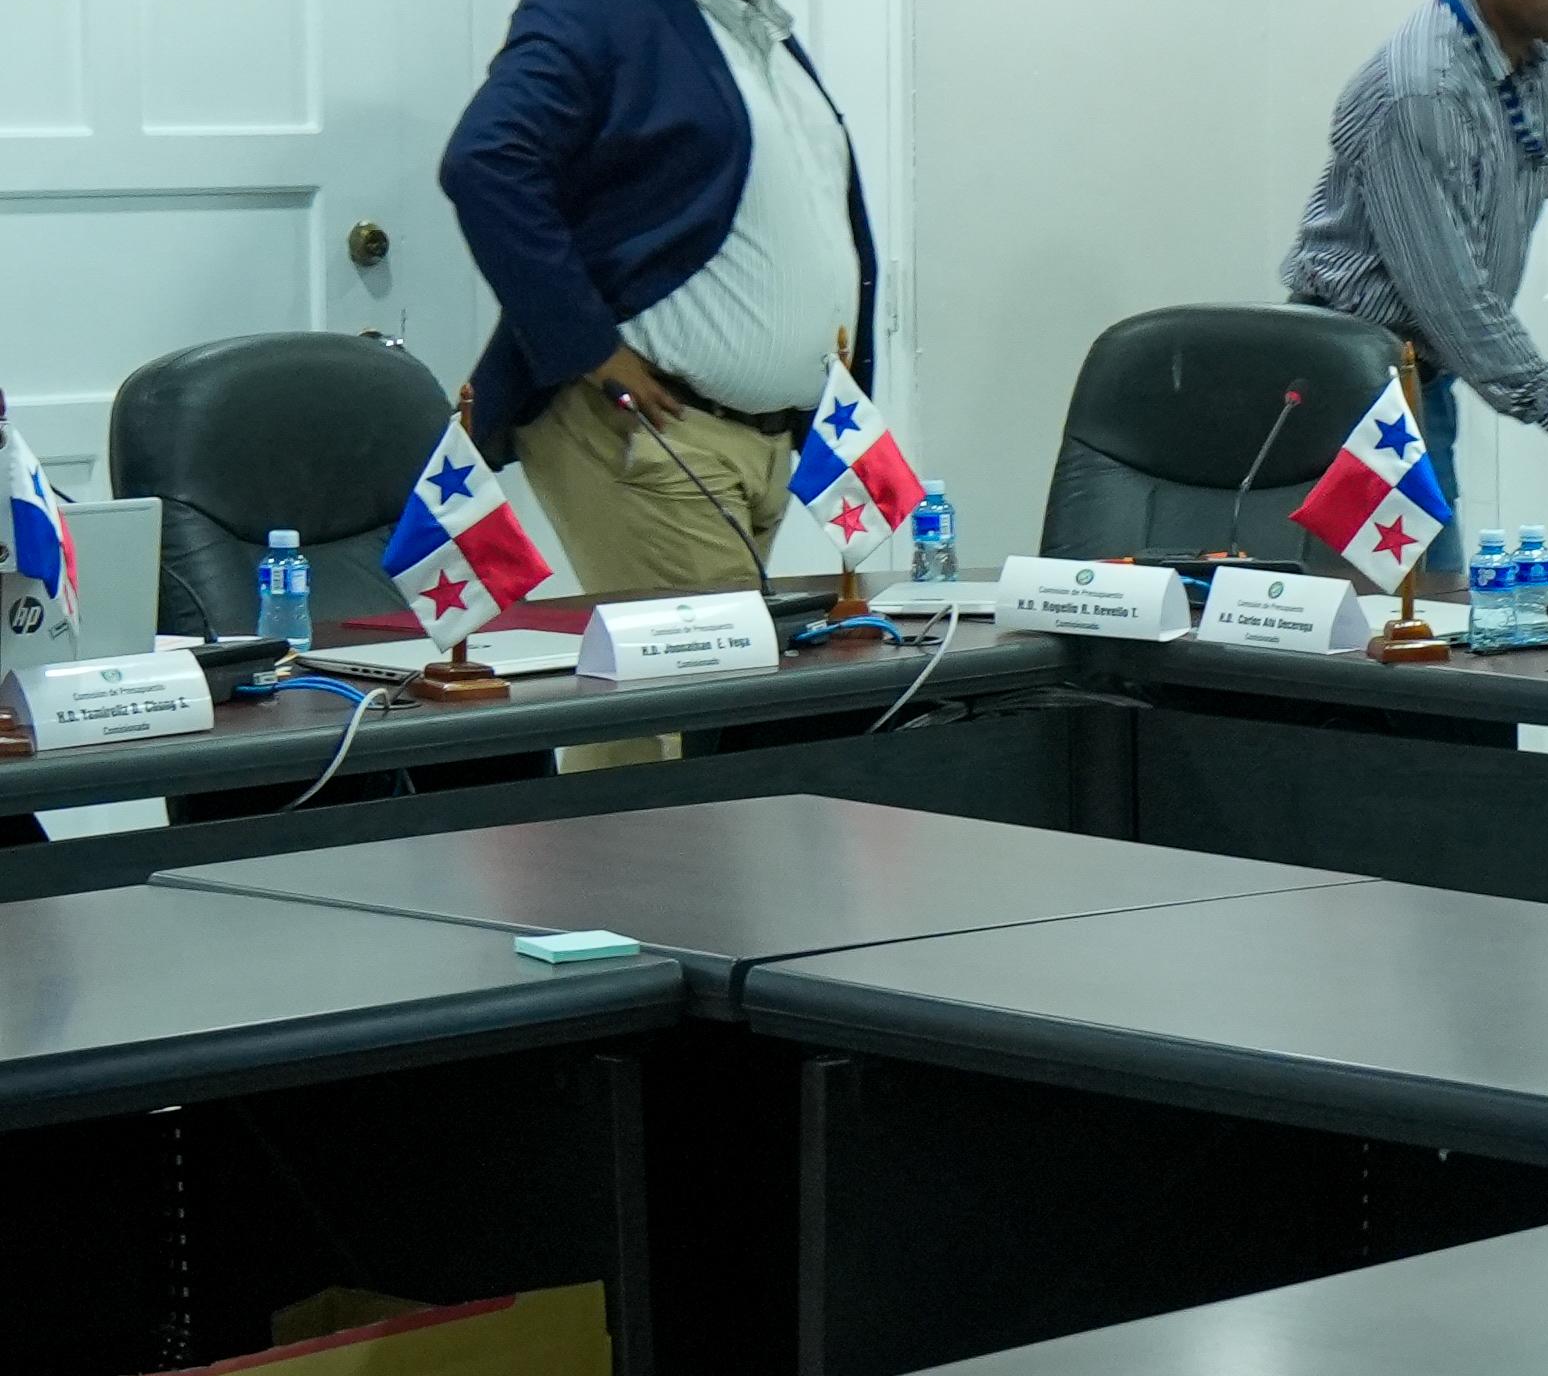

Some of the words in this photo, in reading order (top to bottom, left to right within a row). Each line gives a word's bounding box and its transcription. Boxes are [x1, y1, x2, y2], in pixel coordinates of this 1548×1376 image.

[1018, 599, 1035, 610] H.D.
[1043, 600, 1078, 614] Rogelio
[1219, 612, 1233, 623] H.D.
[1238, 614, 1261, 626] Carlos
[728, 636, 751, 649] Vega
